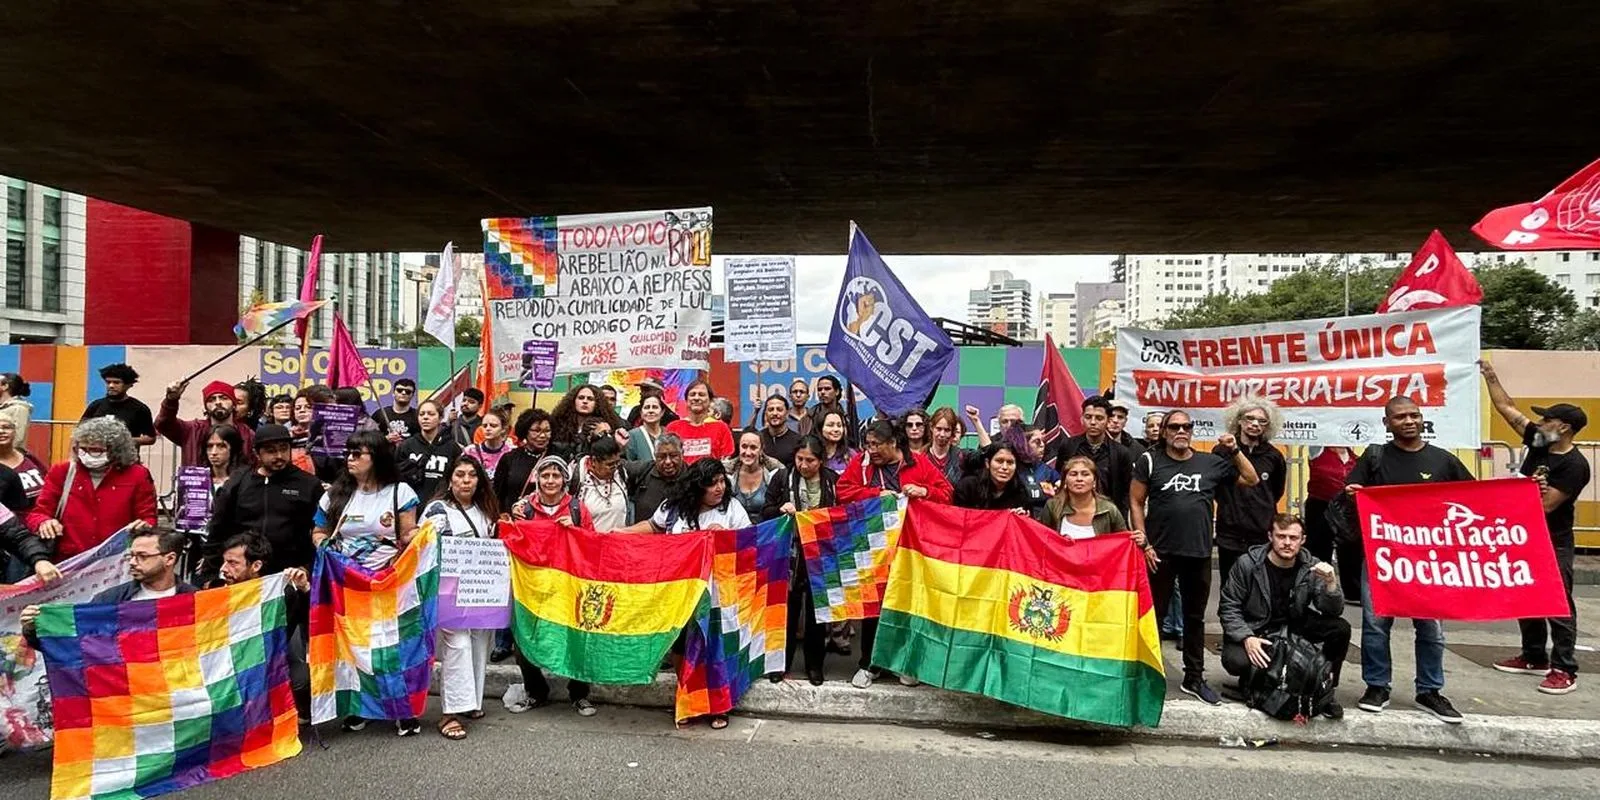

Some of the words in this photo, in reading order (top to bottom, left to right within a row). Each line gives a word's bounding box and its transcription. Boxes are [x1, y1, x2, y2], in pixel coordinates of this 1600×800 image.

[559, 226, 607, 250] TODO
[607, 221, 666, 248] APOIO
[569, 250, 648, 275] REBELIÃO
[651, 255, 667, 270] NA
[570, 276, 624, 297] ABAIXO
[568, 298, 653, 317] CUMPLICIDADE
[661, 300, 674, 310] DE
[532, 321, 567, 339] COM
[573, 318, 631, 336] RODRIGO
[637, 314, 665, 331] PAZ
[581, 342, 617, 355] NOSSA
[629, 332, 677, 344] QUILOMBO
[859, 302, 938, 379] CST
[1142, 337, 1181, 355] POR
[1182, 333, 1307, 367] FRENTE
[1318, 321, 1437, 361] ÚNICA
[580, 352, 617, 366] CLASSE
[629, 344, 675, 356] VERMELHO
[1140, 352, 1183, 366] UMA
[264, 351, 301, 374] So
[1144, 372, 1430, 405] ANTI-IMPERIALISTA
[1351, 424, 1362, 440] 4
[1375, 547, 1535, 589] Socialista
